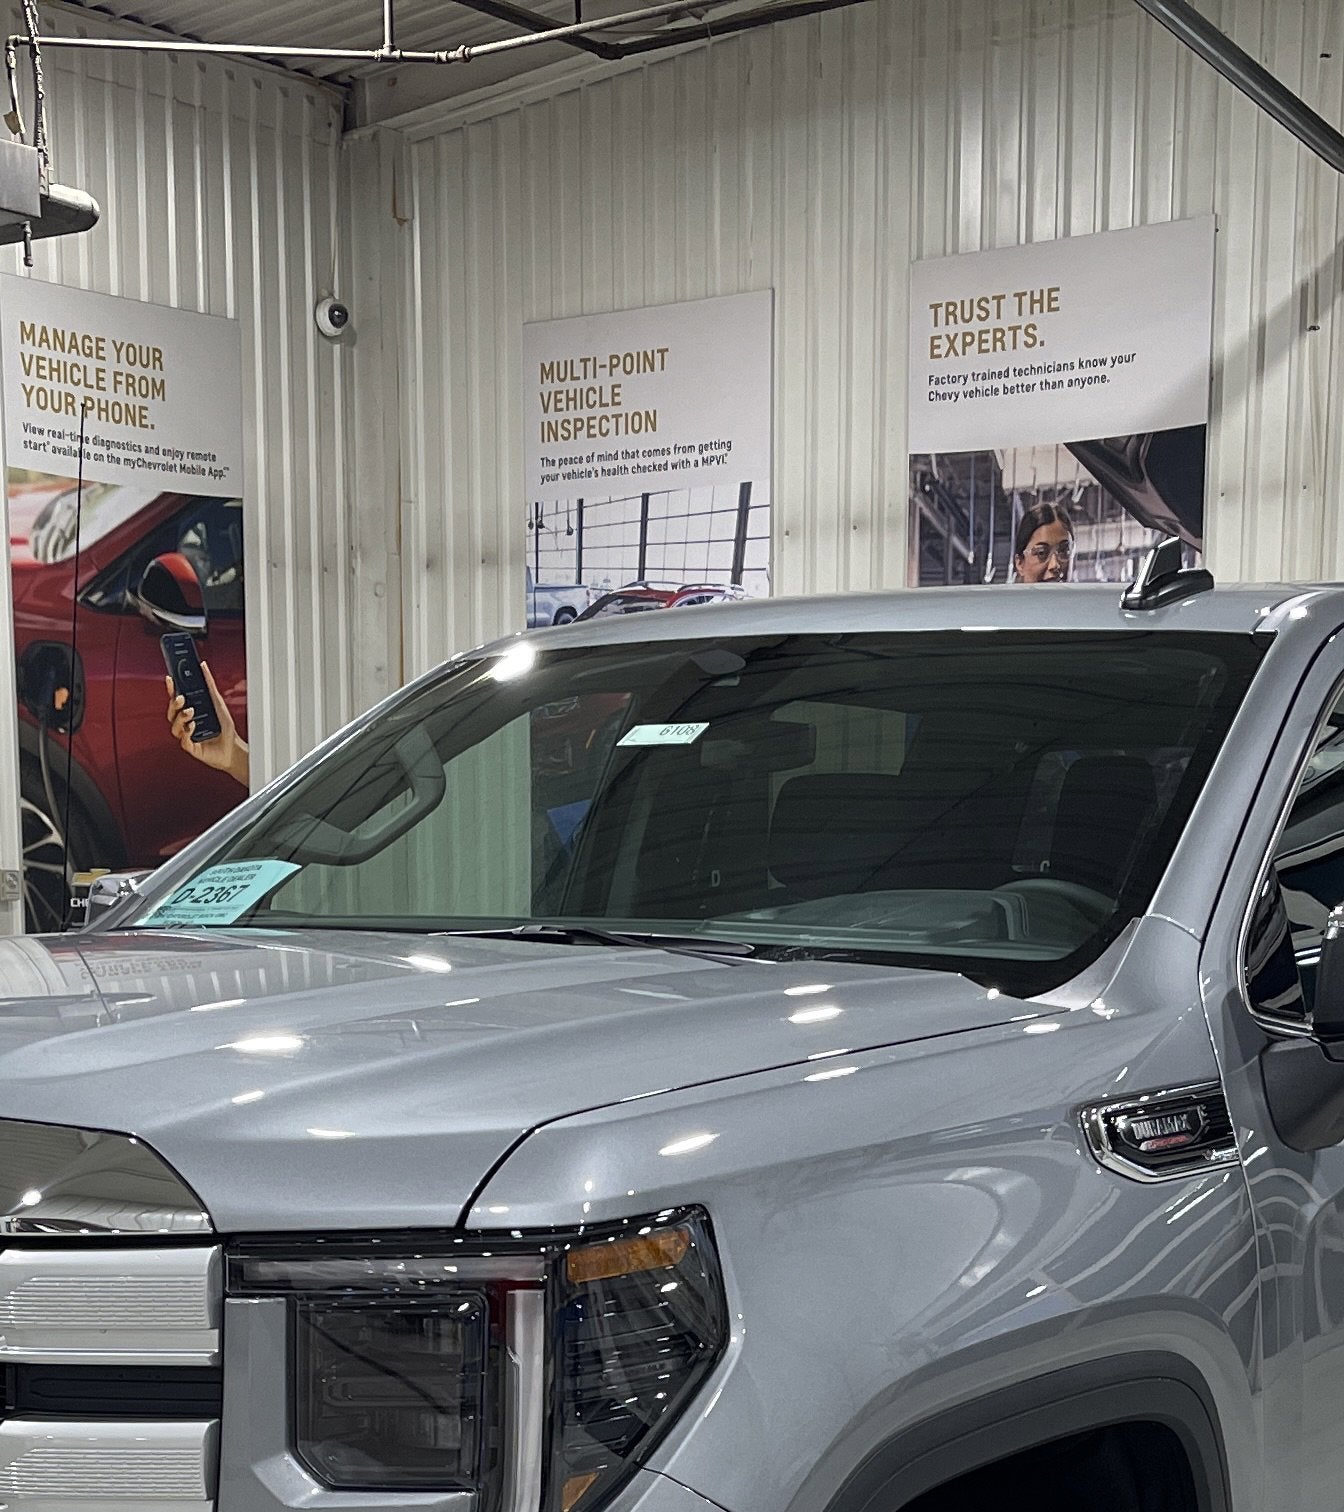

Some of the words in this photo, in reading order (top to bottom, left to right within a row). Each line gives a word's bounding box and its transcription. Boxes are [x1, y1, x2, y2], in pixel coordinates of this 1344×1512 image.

[929, 294, 1006, 328] TRUST
[1013, 287, 1060, 317] THE
[20, 321, 106, 362] MANAGE
[112, 339, 164, 371] YOUR
[929, 323, 1045, 360] EXPERTS.
[20, 352, 106, 391] VEHICLE
[113, 371, 165, 401] FROM
[540, 347, 669, 385] MULTI-POINT
[928, 372, 969, 387] Factory
[971, 367, 1010, 382] trained
[1013, 360, 1075, 377] technicians
[1078, 356, 1107, 370] know
[1110, 353, 1137, 369] your
[540, 383, 622, 414] VEHICLE
[928, 389, 960, 402] Chevy
[963, 385, 1000, 399] vehicle
[1002, 381, 1037, 395] better
[1039, 377, 1065, 391] than
[1067, 373, 1110, 390] anyone.
[21, 383, 77, 417] YOUR
[84, 396, 156, 430] PHONE.
[22, 422, 45, 436] View
[92, 434, 142, 454] diagnostics
[145, 445, 160, 456] and
[162, 447, 185, 461] enjoy
[186, 451, 217, 462] remote
[540, 409, 657, 443] INSPECTION
[93, 452, 104, 462] on
[107, 453, 121, 465] the
[123, 457, 178, 473] myChevrolet
[179, 463, 206, 476] Mobile
[540, 456, 556, 468] The
[558, 456, 584, 470] peace
[585, 452, 595, 464] of
[596, 450, 619, 463] mind
[621, 448, 640, 460] that
[642, 446, 671, 459] comes
[673, 443, 696, 455] from
[698, 439, 732, 454] getting
[540, 473, 559, 486] your
[562, 467, 599, 481] vehicle's
[601, 463, 629, 477] health
[631, 459, 668, 474] checked
[670, 457, 691, 471] with
[693, 460, 699, 468] a
[171, 884, 250, 905] D-2367
